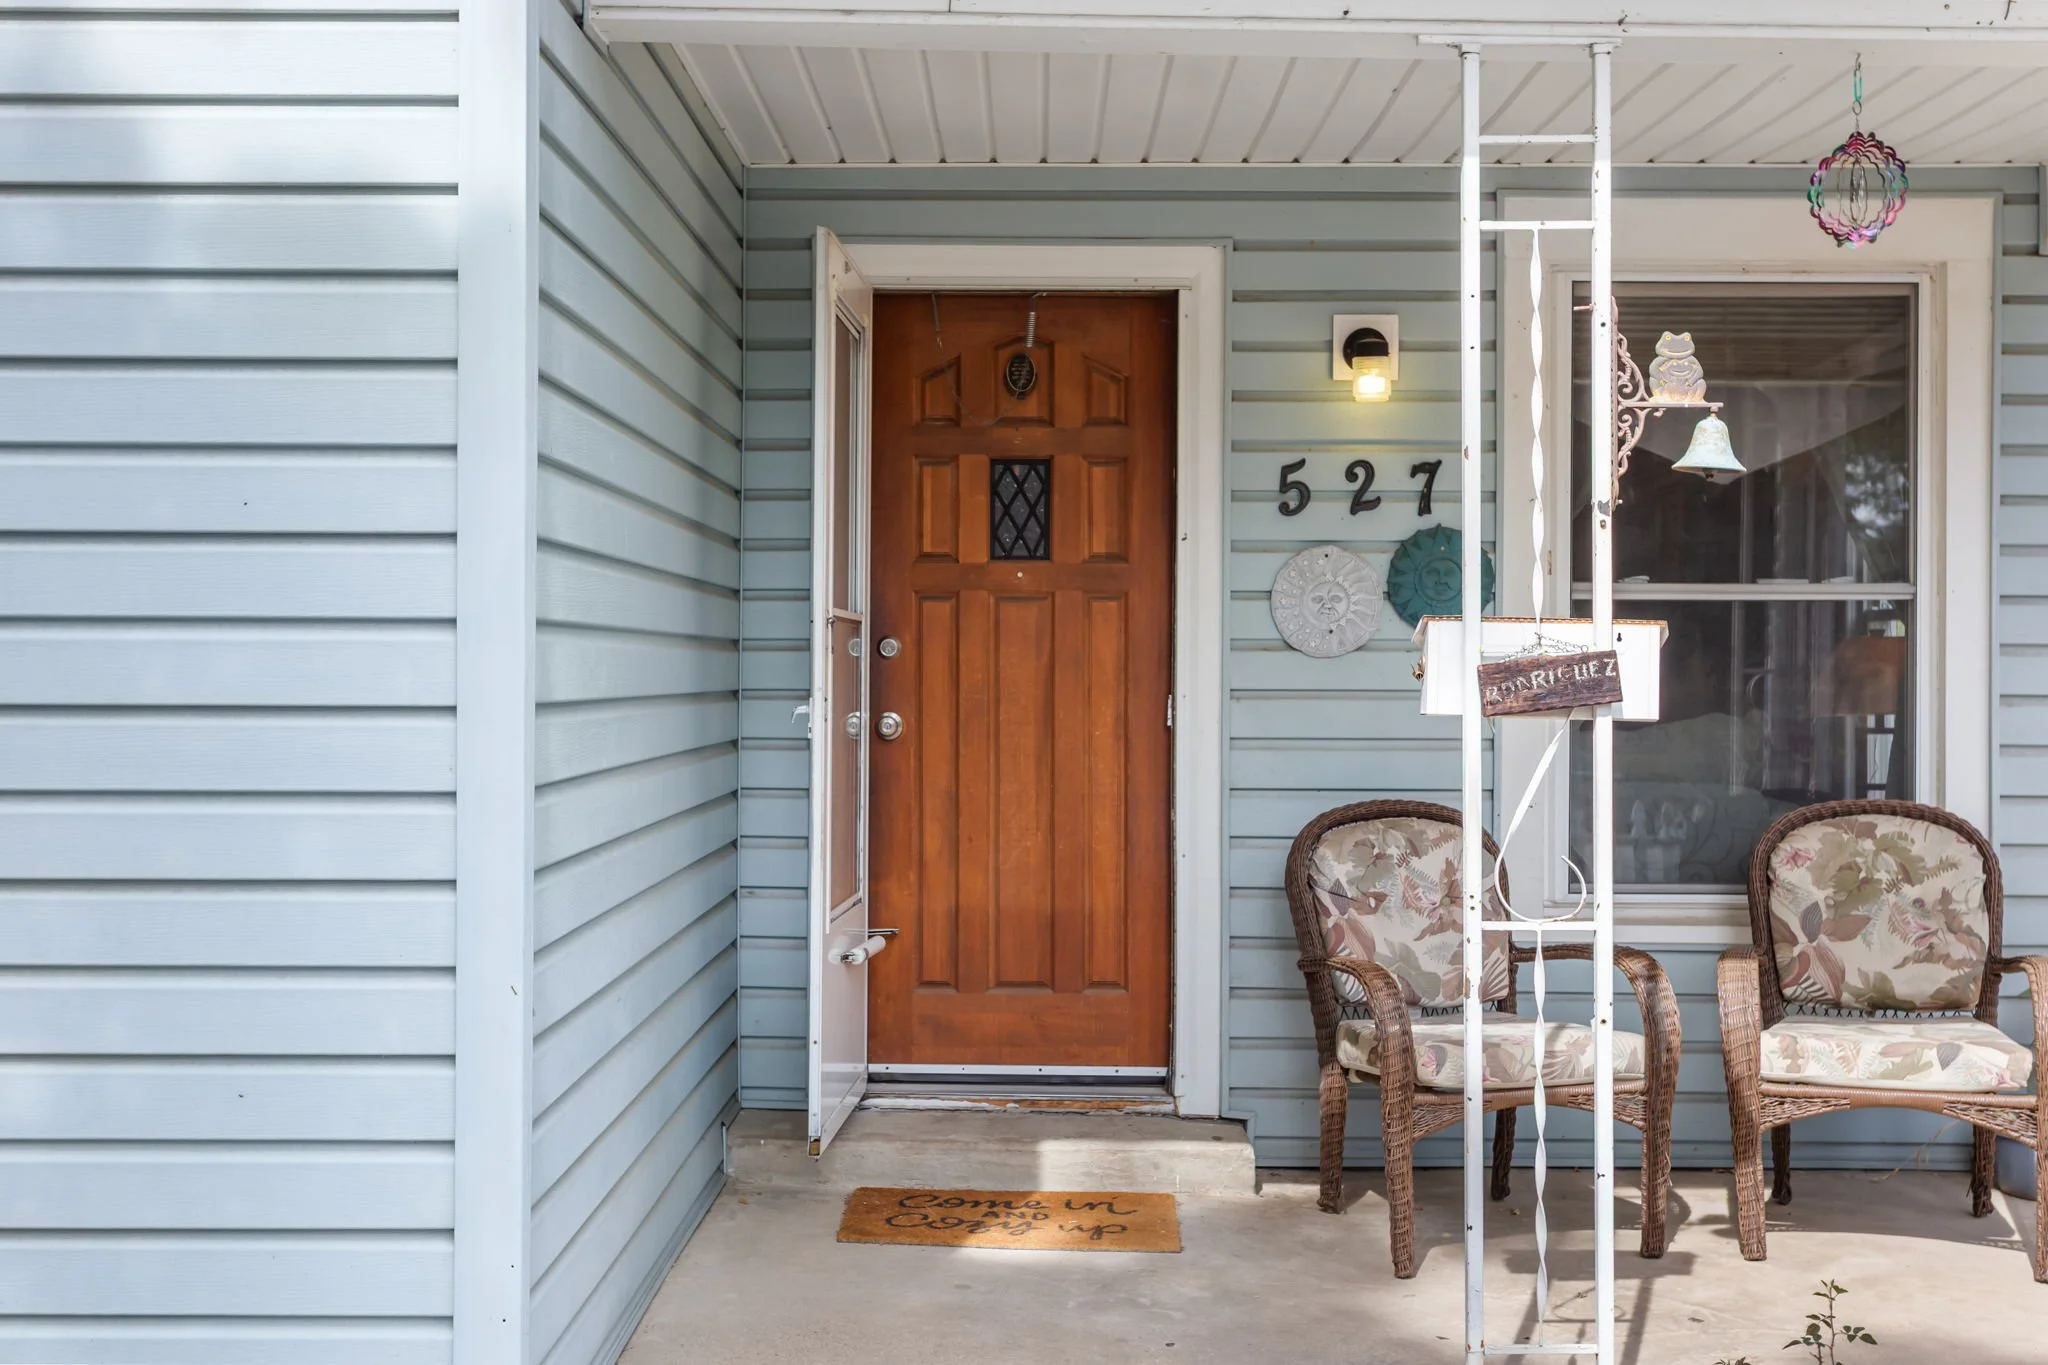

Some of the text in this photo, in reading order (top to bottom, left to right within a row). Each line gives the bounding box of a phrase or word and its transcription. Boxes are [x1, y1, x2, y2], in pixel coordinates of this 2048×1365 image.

[1278, 458, 1442, 516] 527
[899, 1194, 1139, 1215] Come in
[980, 1211, 1049, 1221] AND
[885, 1212, 1128, 1241] Cozy up
